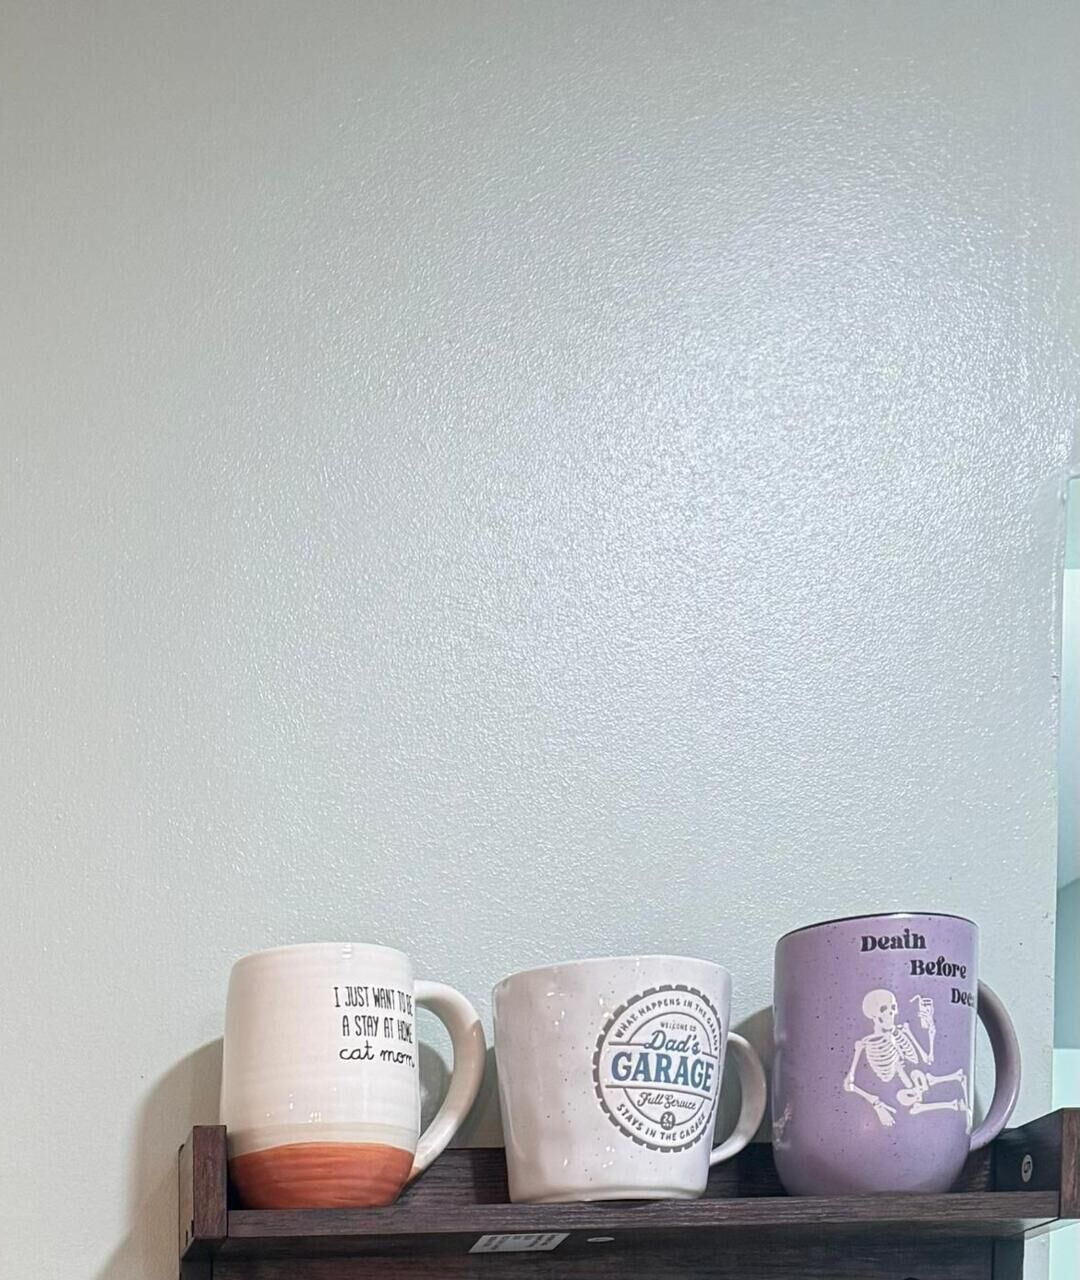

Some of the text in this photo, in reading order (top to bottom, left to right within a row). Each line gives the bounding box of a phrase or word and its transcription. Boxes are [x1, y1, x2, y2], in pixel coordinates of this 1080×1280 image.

[861, 928, 927, 952] Death
[910, 955, 967, 979] Before
[333, 986, 341, 1008] I
[344, 986, 369, 1008] JUST
[372, 987, 395, 1011] WANT
[342, 1015, 413, 1044] A STAY AT HOME
[615, 1015, 639, 1039] WHAT
[639, 998, 681, 1017] HAPPENS
[683, 999, 693, 1009] IN
[695, 1003, 707, 1017] THE
[339, 1040, 415, 1069] cat mom
[643, 1030, 701, 1055] Dad's
[611, 1051, 715, 1093] GARAGE
[637, 1091, 697, 1110] Full Service
[616, 1103, 706, 1142] STAYS IN THE GARAGE
